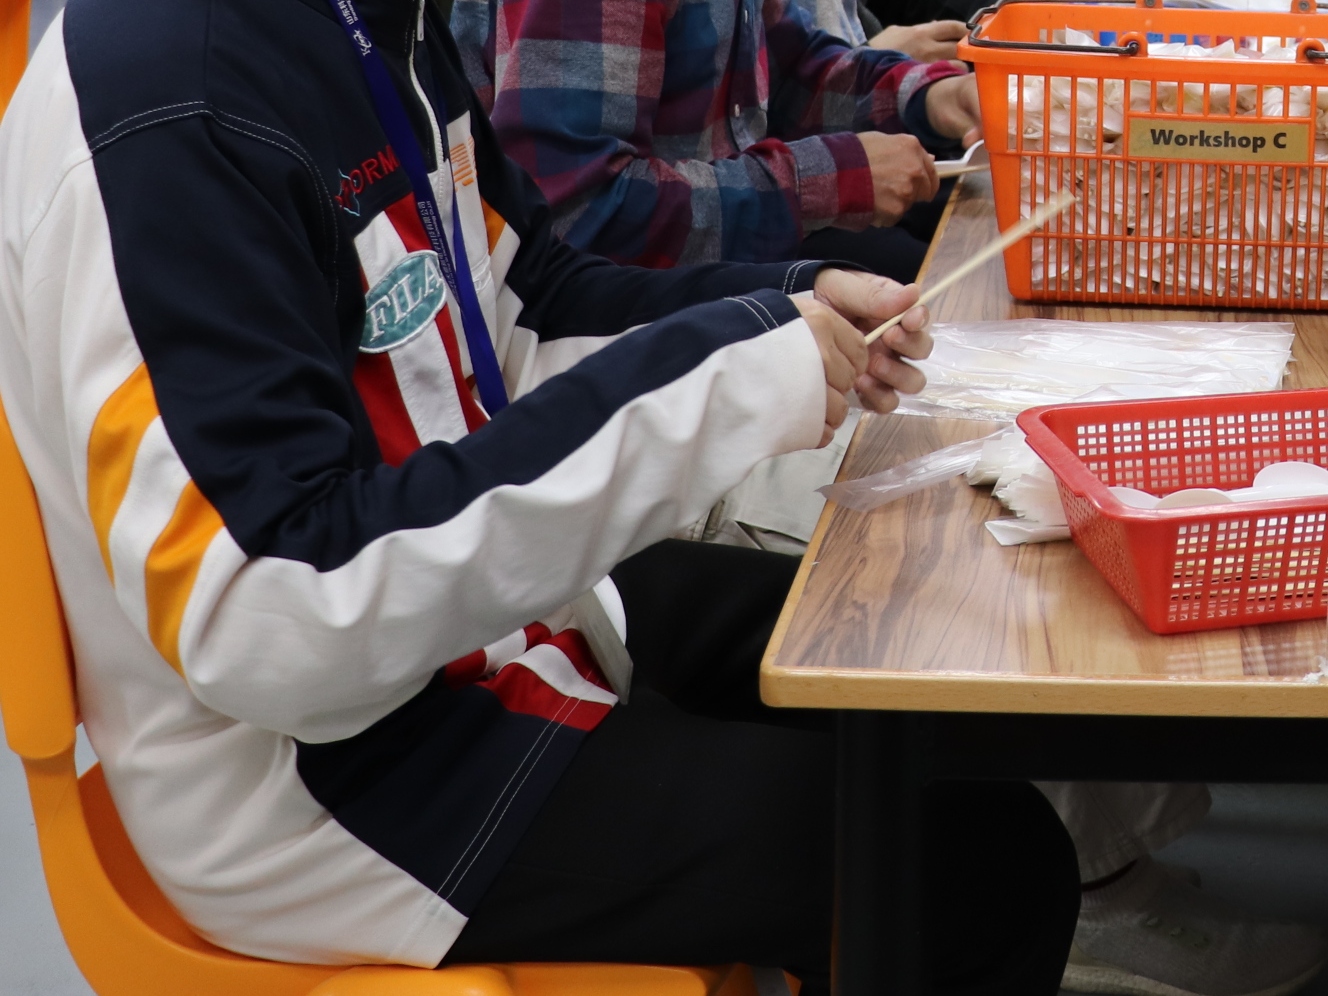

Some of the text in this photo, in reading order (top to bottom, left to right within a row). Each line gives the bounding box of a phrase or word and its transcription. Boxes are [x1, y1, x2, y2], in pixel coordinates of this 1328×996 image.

[1150, 128, 1287, 153] Workshop C
[366, 257, 442, 342] FILA
